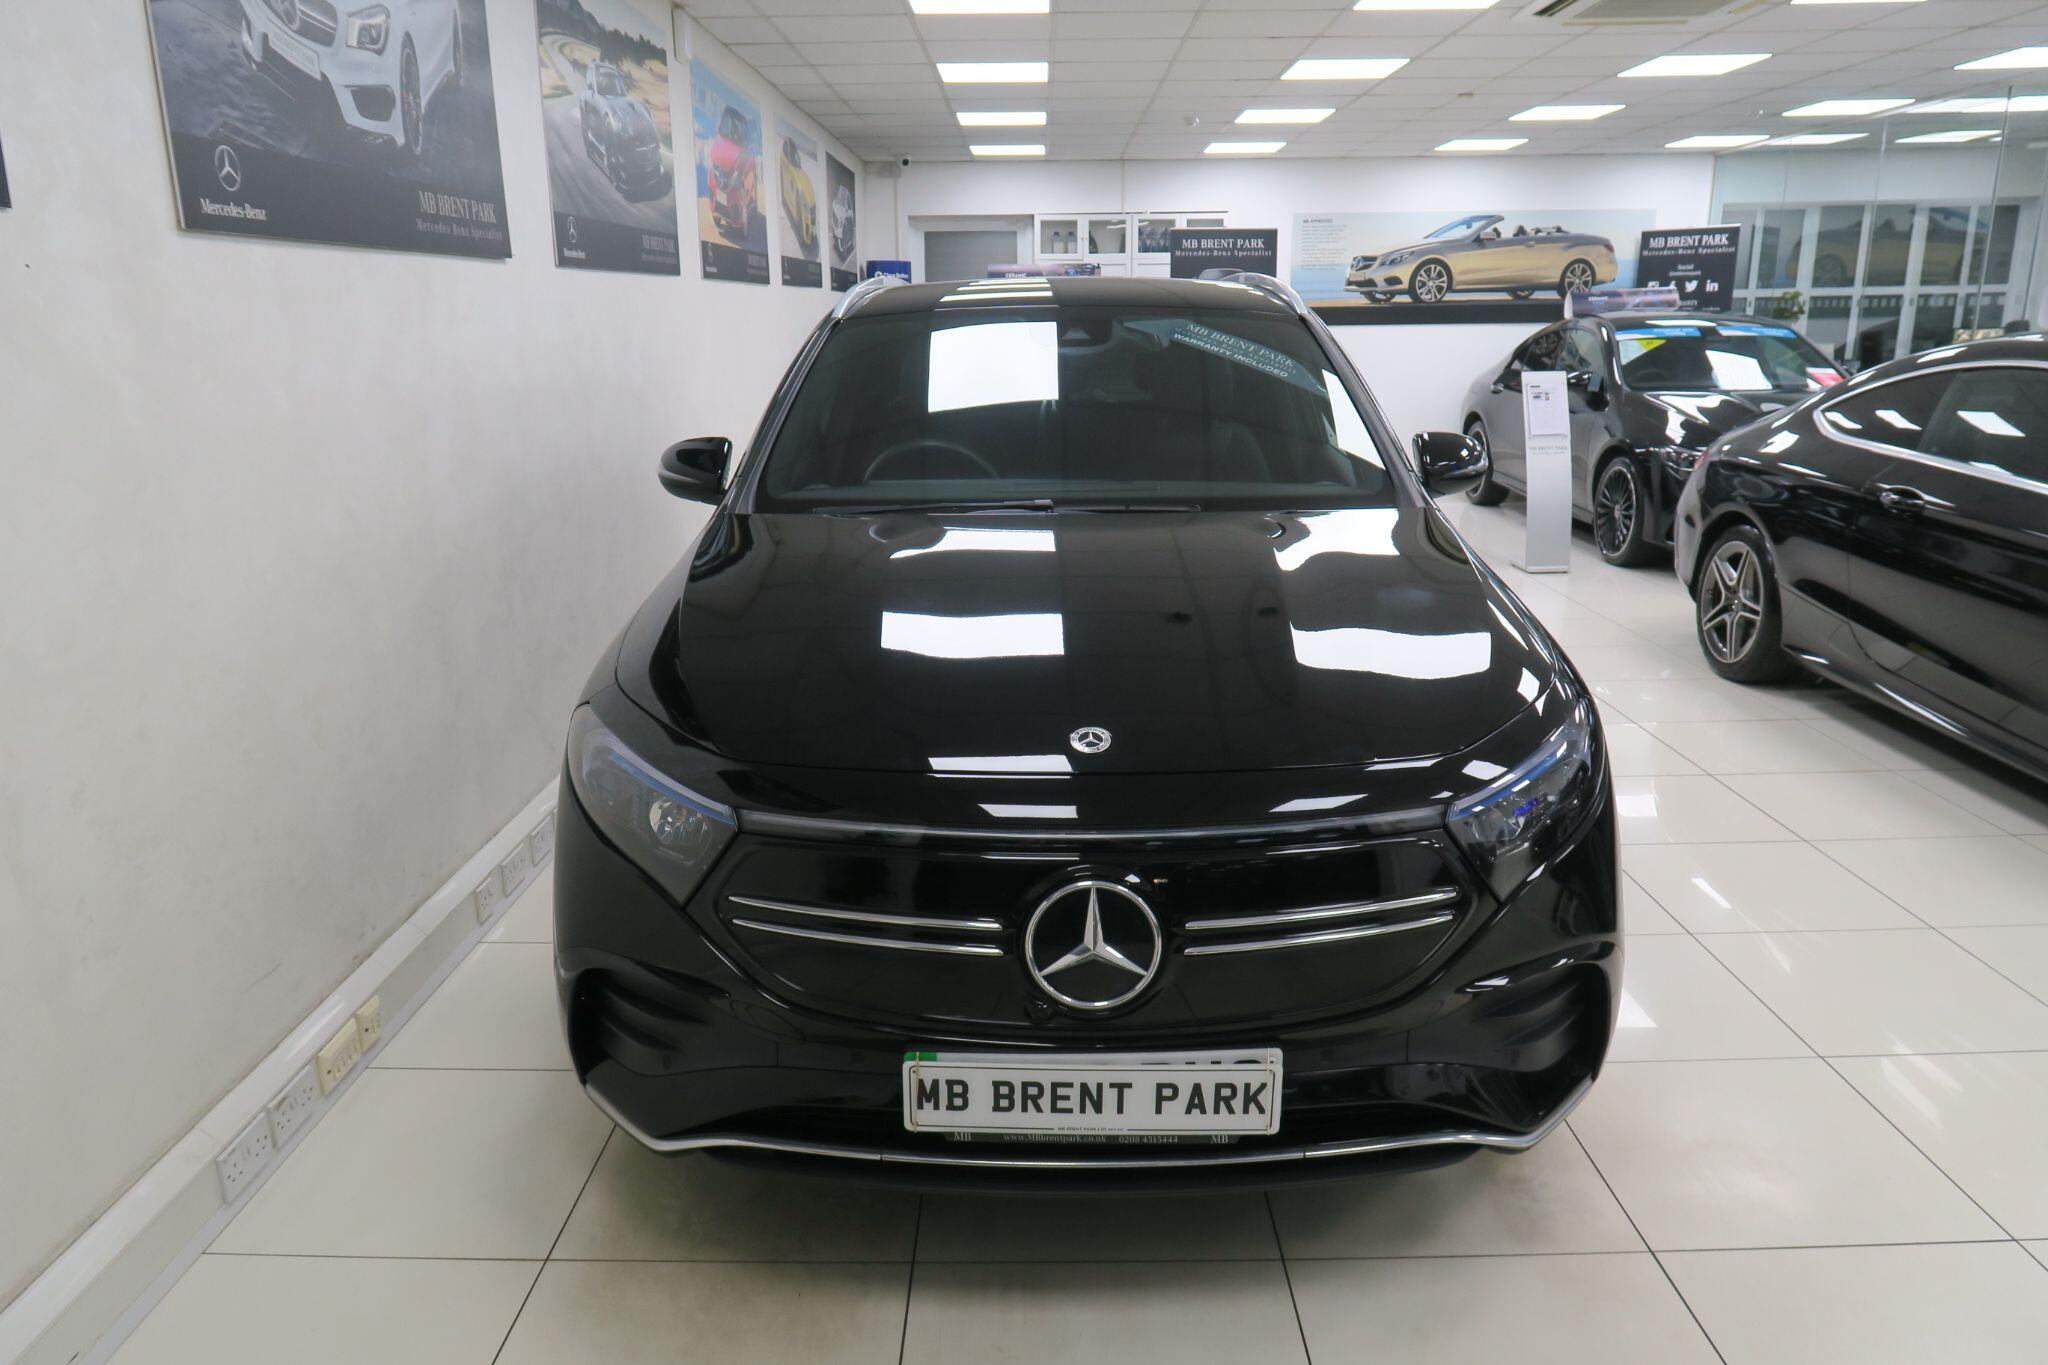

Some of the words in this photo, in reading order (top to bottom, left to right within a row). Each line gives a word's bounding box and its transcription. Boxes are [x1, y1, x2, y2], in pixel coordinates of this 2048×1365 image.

[199, 197, 268, 221] Mercedes-Benz
[419, 190, 437, 214] MB
[437, 194, 471, 219] BRENT
[470, 200, 497, 223] PARK
[1181, 239, 1198, 249] MB
[1200, 239, 1235, 249] BRENT
[1237, 238, 1264, 249] PARK
[1649, 237, 1665, 249] MB
[1666, 234, 1701, 248] BRENT
[1701, 233, 1729, 246] PARK
[1234, 249, 1272, 257] Specialist
[1174, 333, 1232, 356] WARRANTY
[1233, 353, 1288, 377] INCLUDED
[1186, 324, 1209, 336] MB
[1210, 331, 1256, 353] BRENT
[1258, 348, 1295, 367] PARK
[916, 1079, 969, 1111] MB
[992, 1080, 1133, 1115] BRENT
[1154, 1082, 1268, 1115] PARK
[954, 1132, 972, 1142] MB
[1211, 1134, 1229, 1144] MB
